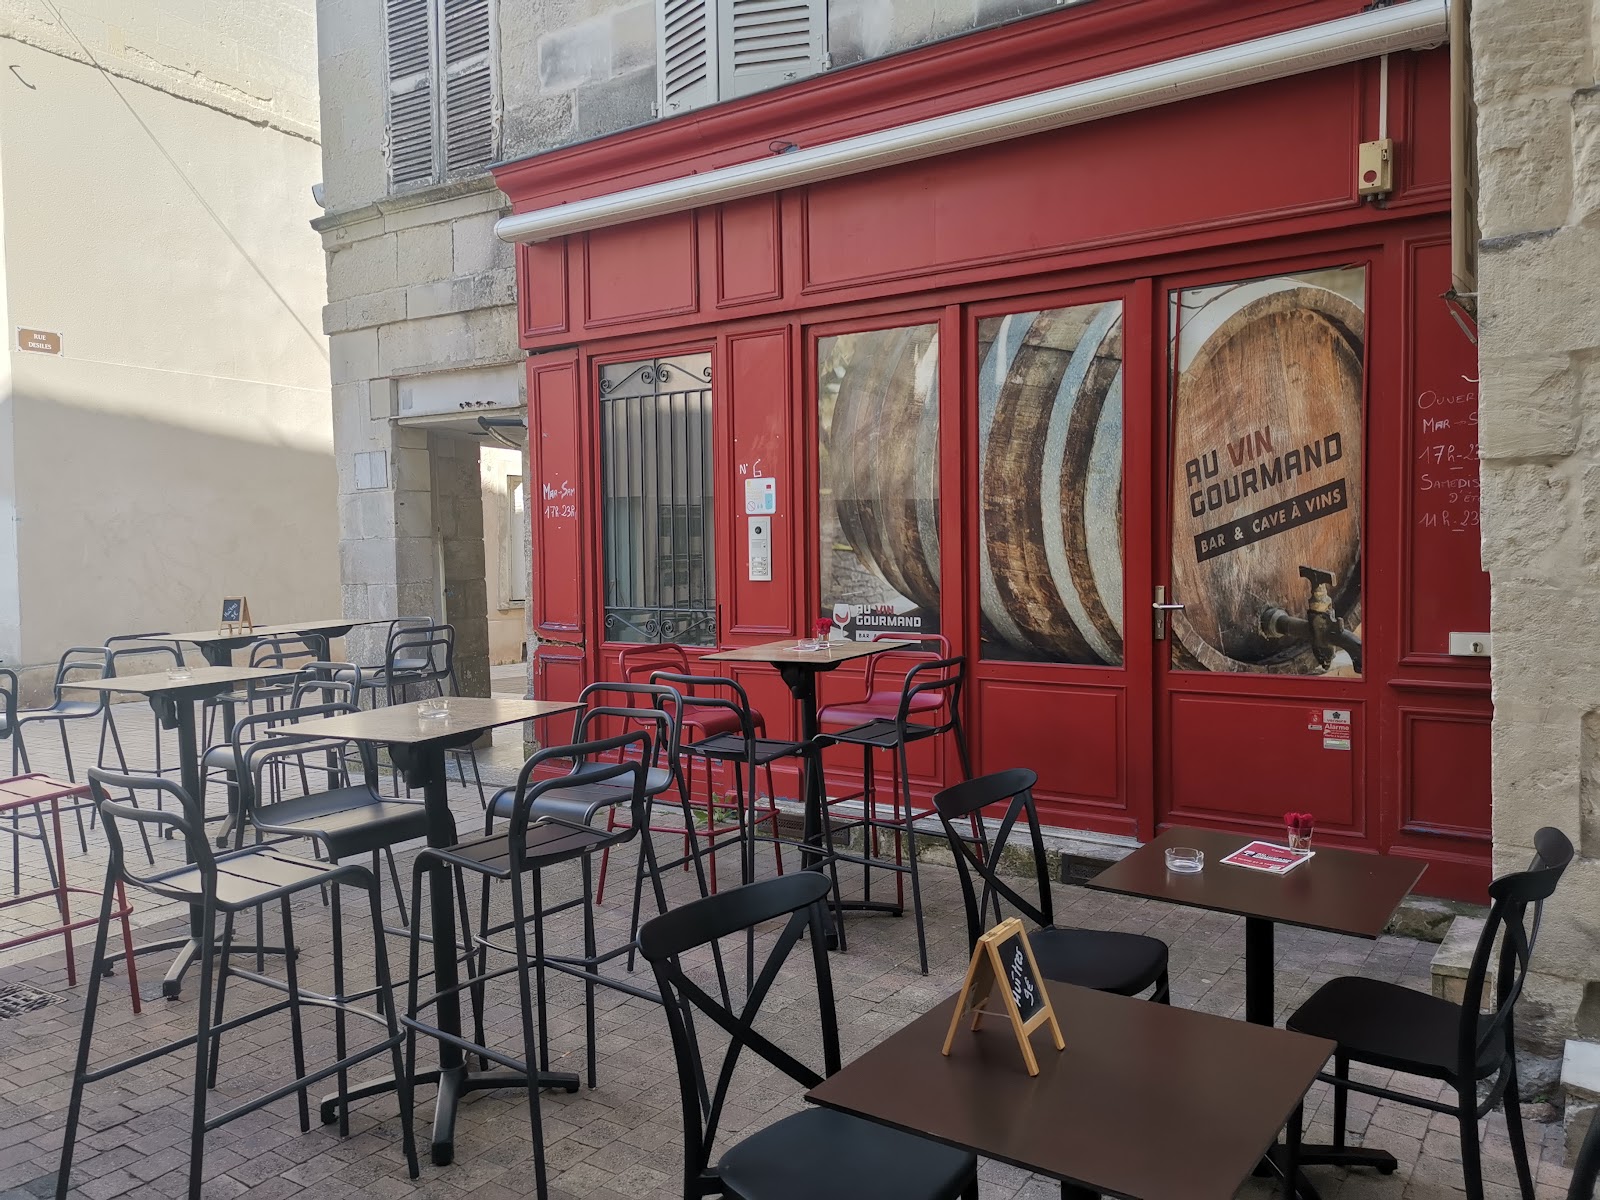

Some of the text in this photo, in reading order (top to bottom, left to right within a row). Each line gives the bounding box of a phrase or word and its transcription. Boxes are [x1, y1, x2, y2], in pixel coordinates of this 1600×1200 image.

[33, 333, 47, 341] RUE
[1417, 390, 1475, 409] OUVER
[1467, 411, 1479, 426] S
[1185, 425, 1274, 487] AU VIN
[752, 458, 762, 478] 6
[1189, 431, 1343, 518] GOURMAND
[1200, 488, 1342, 554] BAR & CAVE À VINS
[856, 604, 895, 615] AU VIN
[855, 615, 922, 628] GOURMAND
[1324, 723, 1350, 731] Alarme
